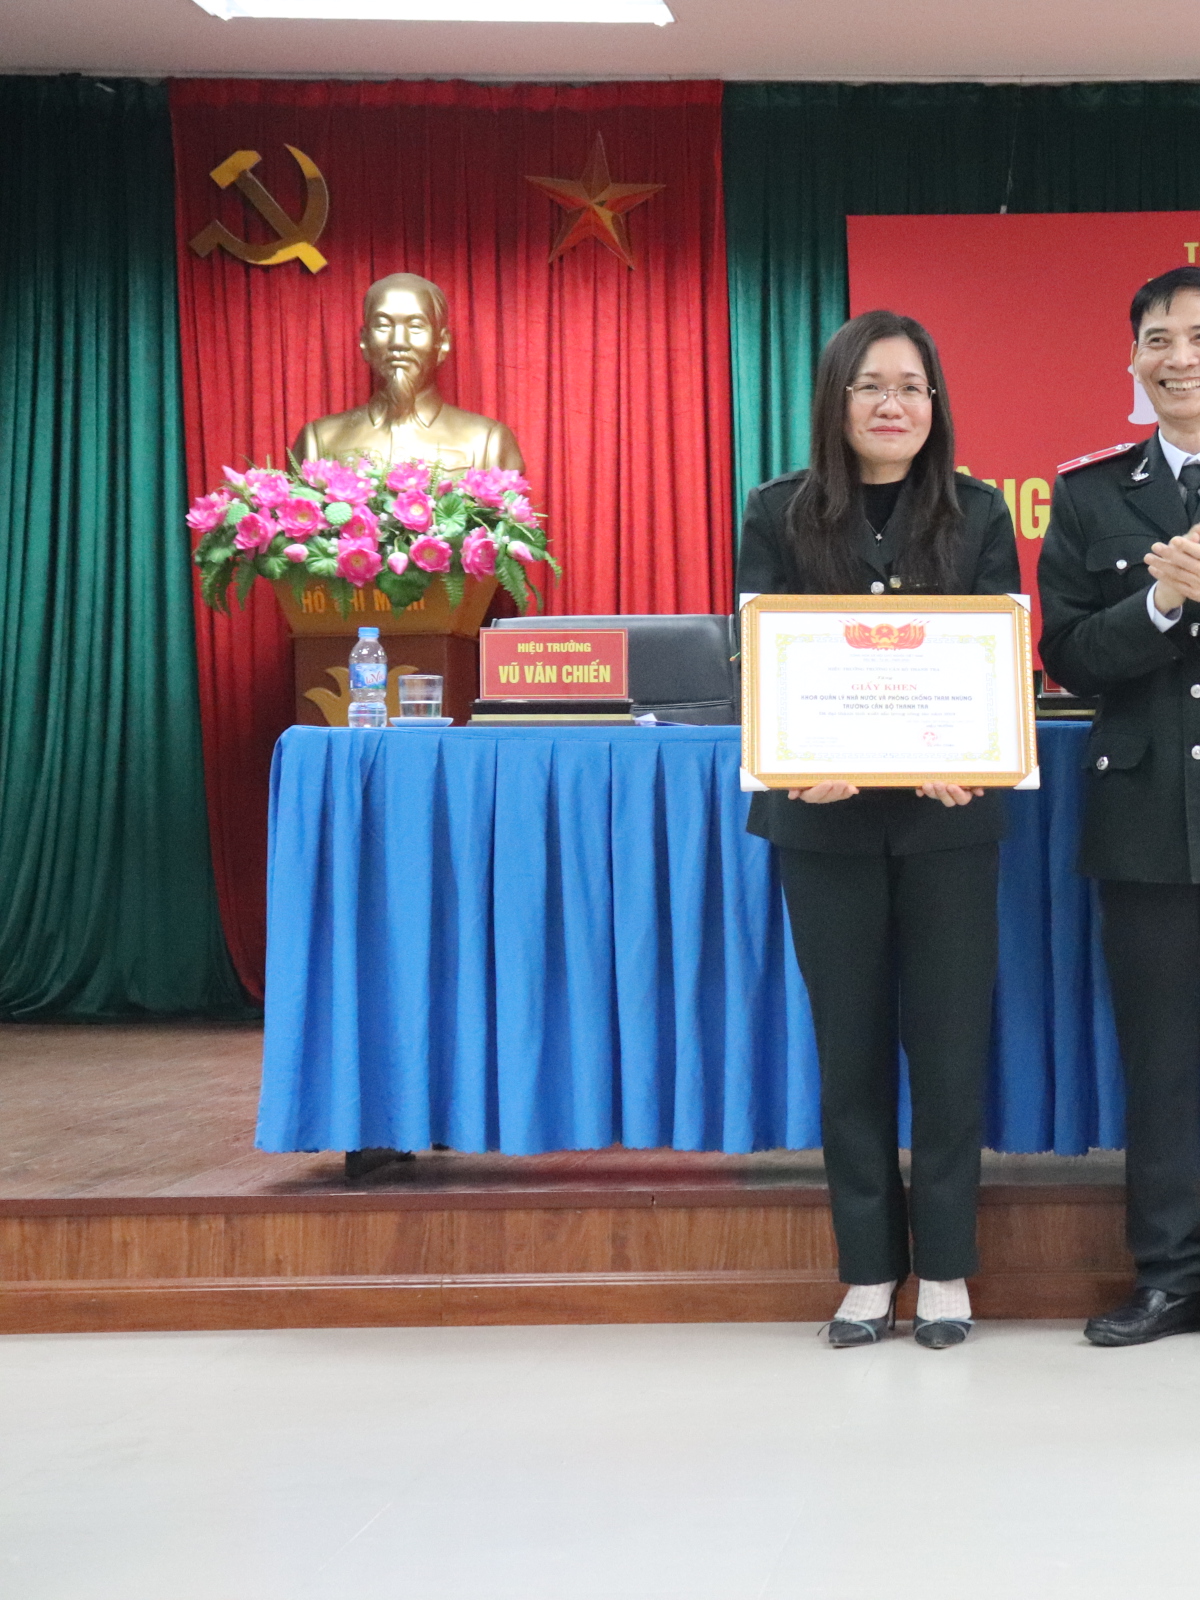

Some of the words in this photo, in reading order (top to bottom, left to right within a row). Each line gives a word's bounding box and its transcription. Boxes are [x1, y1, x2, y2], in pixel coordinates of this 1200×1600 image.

[517, 641, 544, 654] HIỆU
[498, 662, 520, 683] VŨ
[524, 661, 557, 683] VĂN
[561, 659, 611, 683] CHIẾN
[851, 681, 881, 691] GIẤY
[884, 683, 918, 691] KHEN
